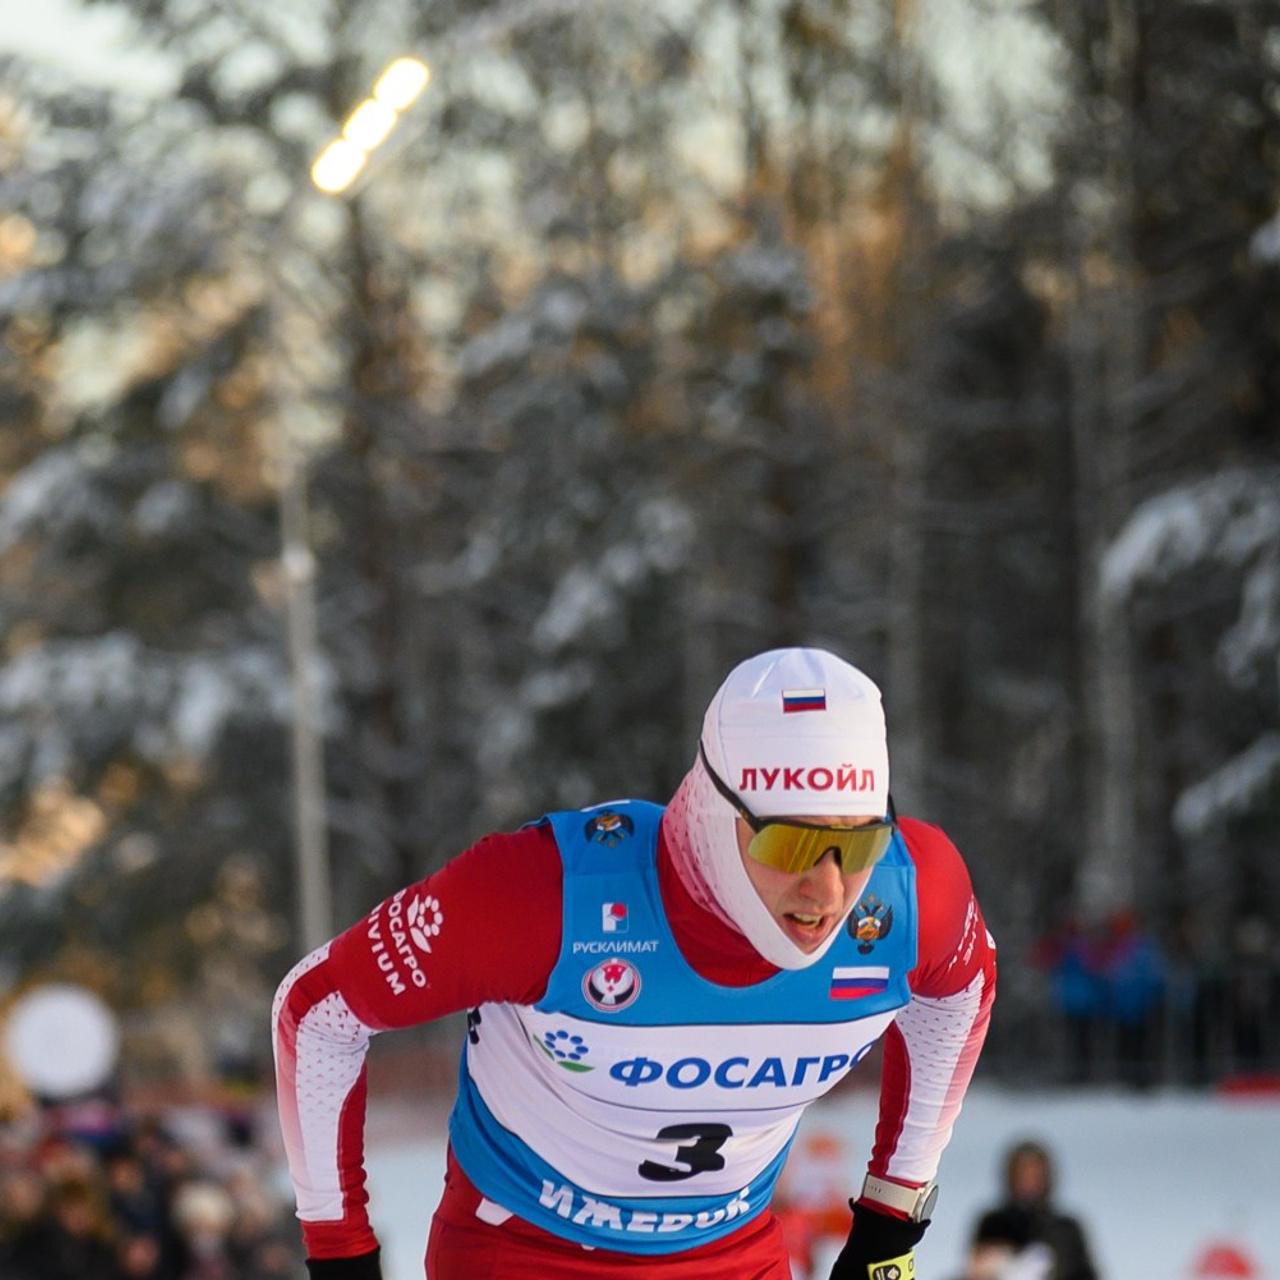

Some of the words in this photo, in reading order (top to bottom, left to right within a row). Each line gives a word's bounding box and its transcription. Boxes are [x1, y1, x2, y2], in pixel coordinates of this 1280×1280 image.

[739, 763, 875, 792] ЛУКОЙЛ
[367, 901, 406, 996] IVIUM
[572, 940, 660, 955] РУСКЛИМАТ
[638, 1122, 733, 1182] 3
